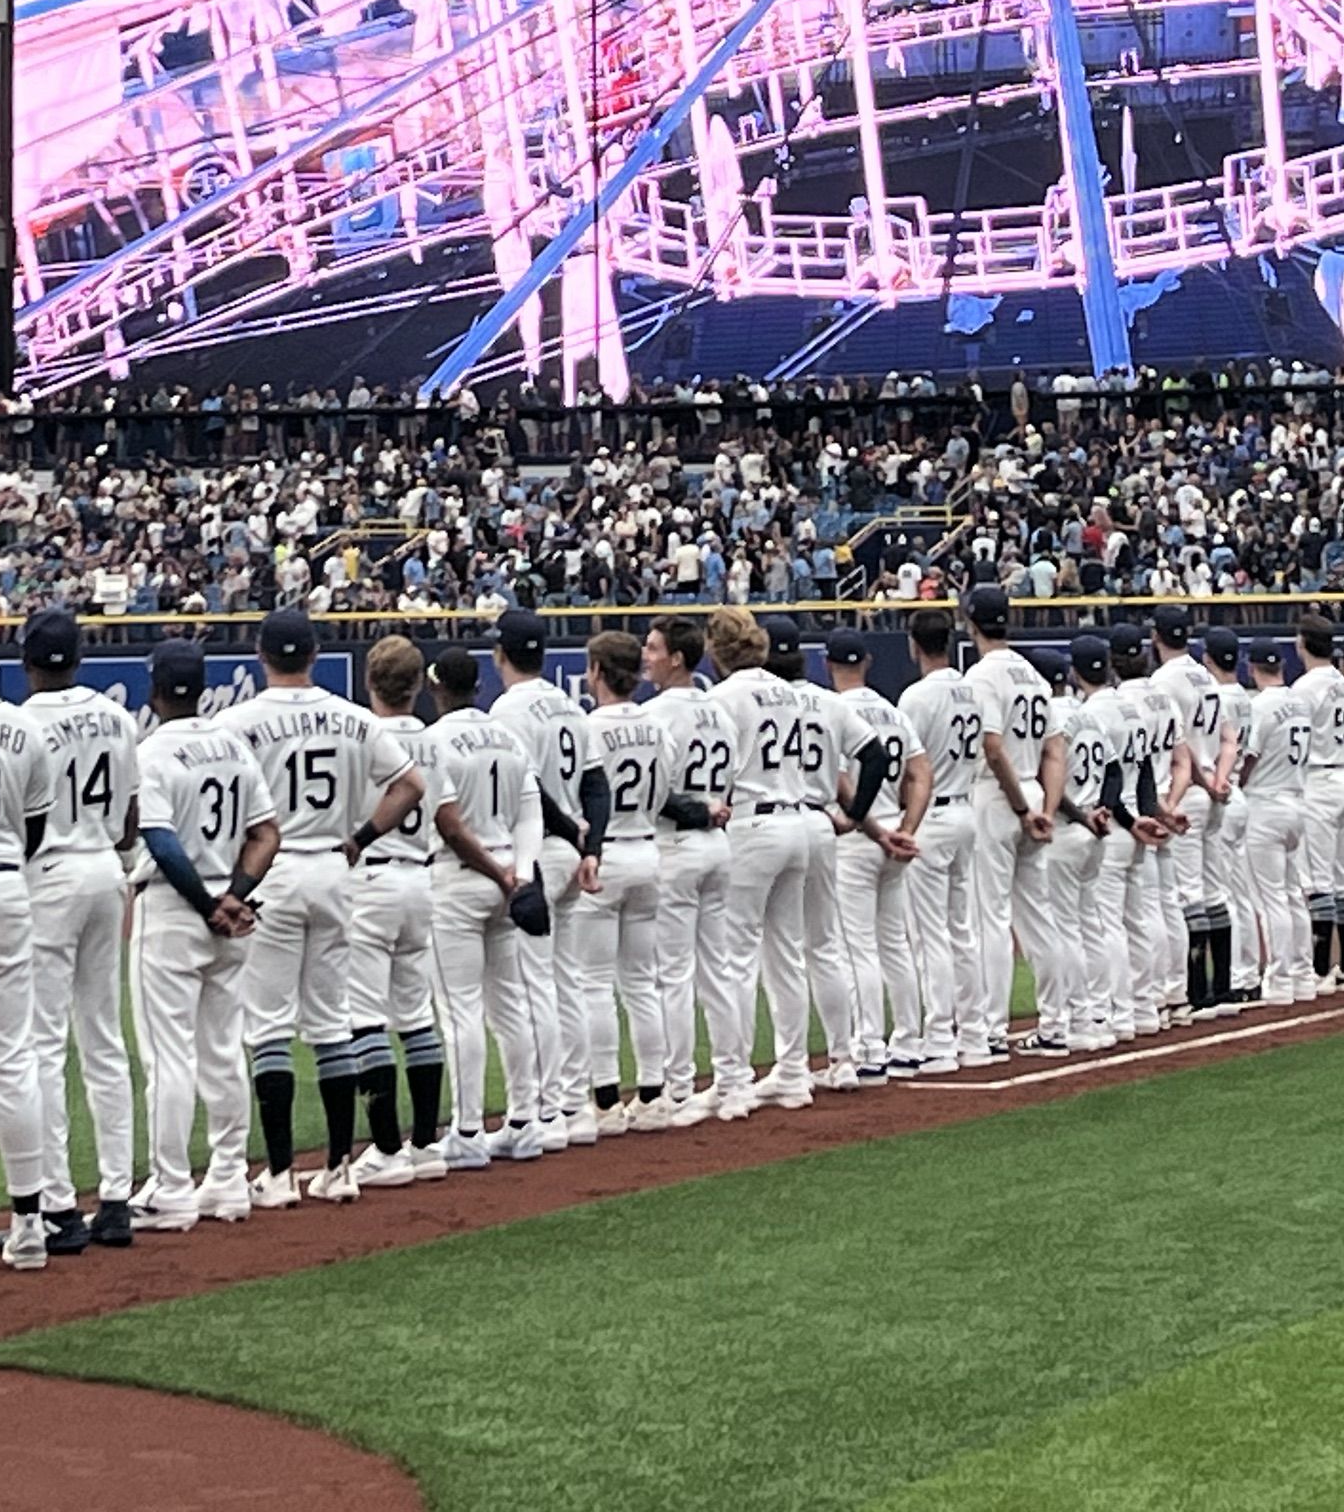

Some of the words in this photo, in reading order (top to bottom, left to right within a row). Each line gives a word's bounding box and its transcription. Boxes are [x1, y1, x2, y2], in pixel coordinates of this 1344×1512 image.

[948, 712, 982, 761] 32
[1012, 694, 1048, 740] 36
[1192, 693, 1221, 736] 47
[559, 726, 576, 781] 9
[683, 739, 730, 793] 22
[759, 718, 803, 771] 24
[66, 751, 113, 825] 14
[285, 748, 337, 812] 15
[490, 759, 499, 817] 1
[614, 758, 658, 813] 21
[199, 775, 240, 841] 31
